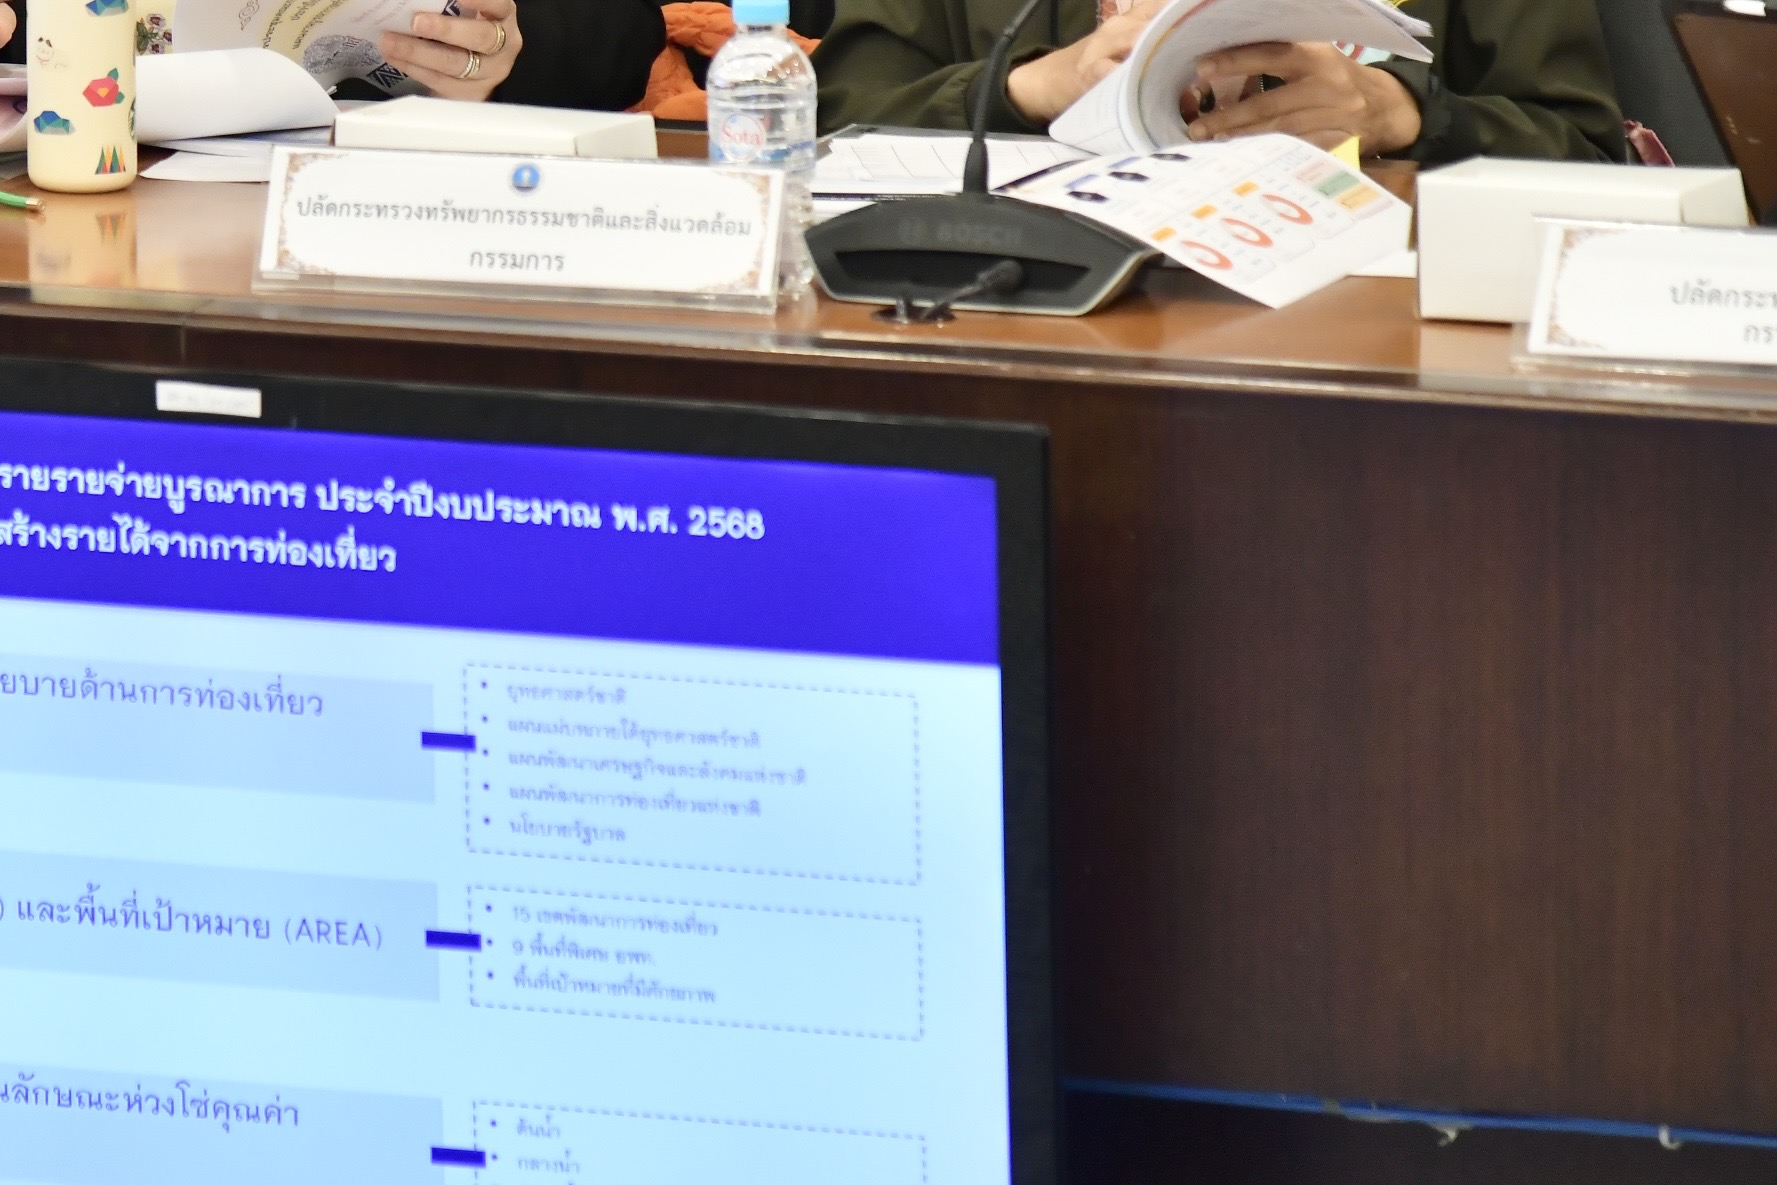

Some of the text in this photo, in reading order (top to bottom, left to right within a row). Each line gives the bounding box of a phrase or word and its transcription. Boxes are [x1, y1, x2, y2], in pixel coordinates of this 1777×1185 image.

[297, 194, 752, 237] ปลัดกระทรวงทรัพยากรธรรมชาติและสิ่งแวดล้อม
[470, 250, 566, 272] กรรมการ
[1743, 323, 1777, 346] กร
[315, 475, 602, 530] ประจำปีงบประมาณ
[611, 502, 679, 535] พ.ศ.
[688, 505, 766, 540] 2568
[17, 881, 271, 941] และพื้นที่เป้าหมาย
[283, 916, 383, 951] (AREA)
